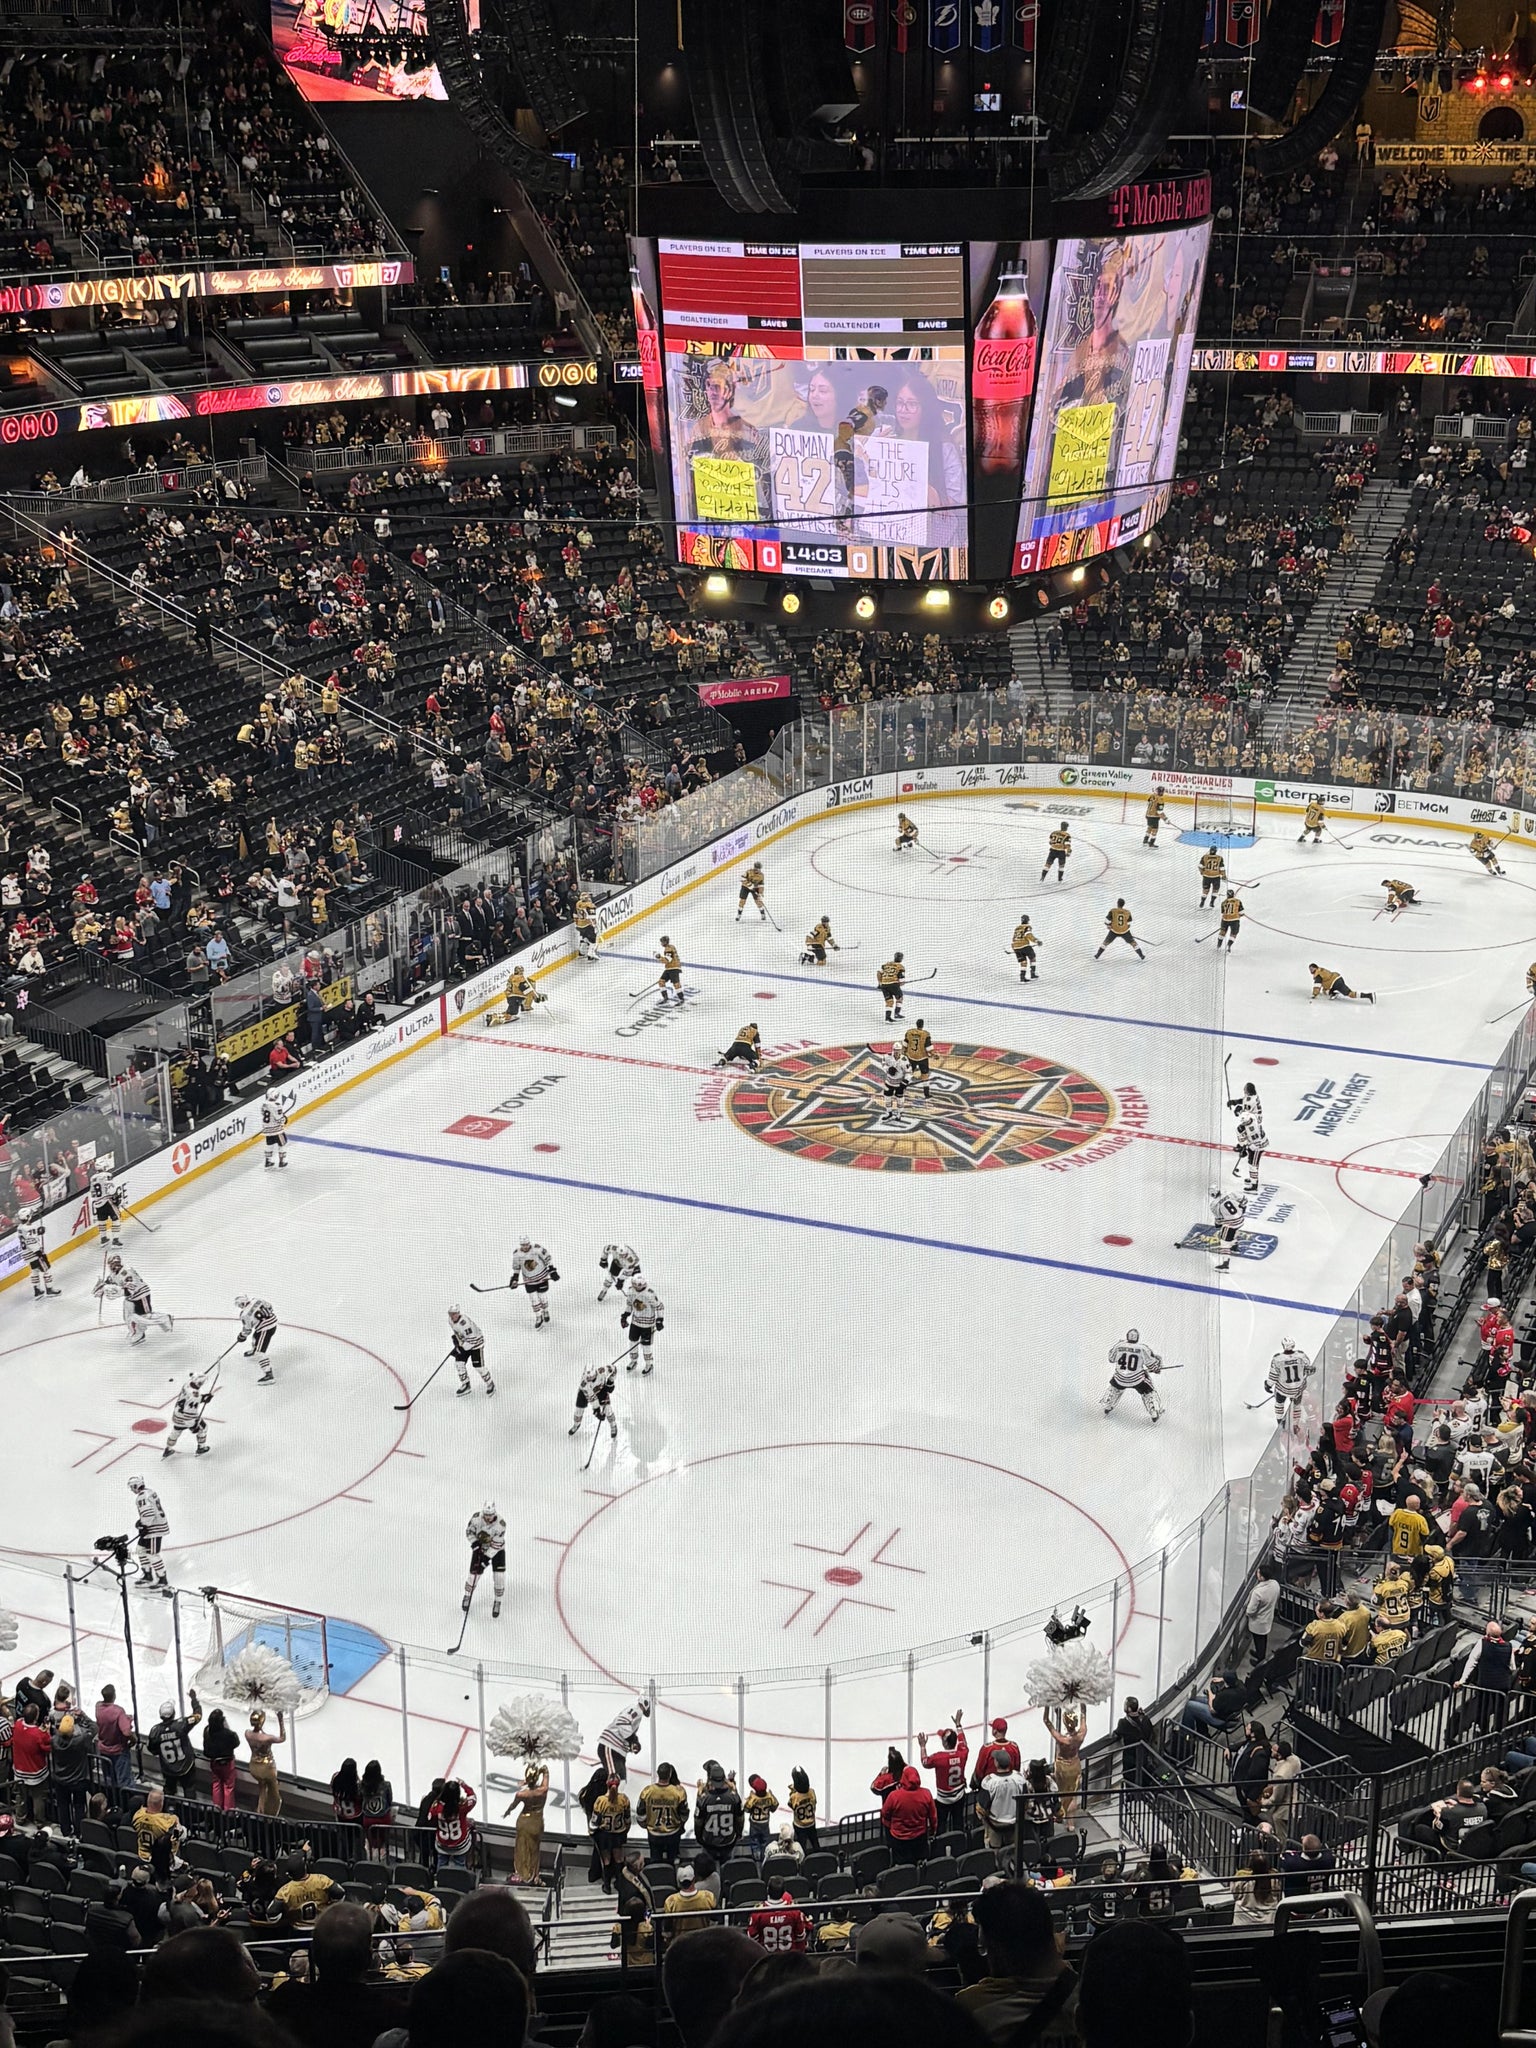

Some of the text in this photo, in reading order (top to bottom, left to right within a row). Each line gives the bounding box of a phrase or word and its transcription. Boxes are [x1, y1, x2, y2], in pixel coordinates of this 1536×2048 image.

[1378, 147, 1445, 160] WELCOME
[1450, 147, 1467, 161] TO
[1497, 147, 1521, 161] THE
[669, 243, 732, 254] PLAYERS ON ICE
[746, 246, 797, 256] TIME ON ICE
[813, 247, 887, 257] PLAYERS ON ICE
[903, 246, 960, 256] TIME ON ICE
[679, 315, 729, 326] GOALTENDER
[760, 319, 788, 329] SAVES
[823, 320, 881, 330] GOALTENDER
[916, 320, 948, 330] SAVES
[1268, 356, 1278, 367] 0
[1326, 356, 1337, 368] 0
[774, 432, 828, 459] BOWMAN
[876, 440, 904, 461] THE
[774, 456, 836, 515] 42
[881, 481, 900, 498] IS
[785, 545, 843, 563] 14:03
[1020, 541, 1036, 552] SOG
[762, 545, 777, 567] 0
[852, 552, 868, 573] 0
[1020, 553, 1031, 570] 0
[1080, 768, 1107, 778] Green
[1151, 771, 1188, 784] ARIZONA
[1191, 775, 1233, 788] CHARLIES
[842, 778, 873, 796] MGM
[1258, 787, 1351, 804] enterprise
[1397, 799, 1449, 815] BETMGM
[1470, 808, 1501, 822] GHOST
[1117, 913, 1125, 926] 9
[404, 1012, 435, 1036] ULTRA
[912, 1037, 920, 1051] 3
[488, 1074, 568, 1114] TOYOTA
[1113, 1085, 1150, 1129] ARENA
[1311, 1072, 1373, 1137] AMERICA FIRST
[194, 1114, 248, 1161] paylocity
[1225, 1202, 1237, 1216] 8
[1267, 1201, 1297, 1224] Bank
[1243, 1235, 1275, 1258] RBC
[1117, 1353, 1139, 1371] 40
[1283, 1365, 1300, 1383] 11
[1472, 1414, 1481, 1432] 9
[1399, 1530, 1410, 1549] 9
[1323, 1639, 1336, 1659] 9
[159, 1740, 186, 1764] 61
[947, 1766, 962, 1786] 2
[651, 1806, 675, 1828] 71
[704, 1812, 735, 1837] 49
[437, 1818, 461, 1841] 98
[1104, 1901, 1116, 1918] 9
